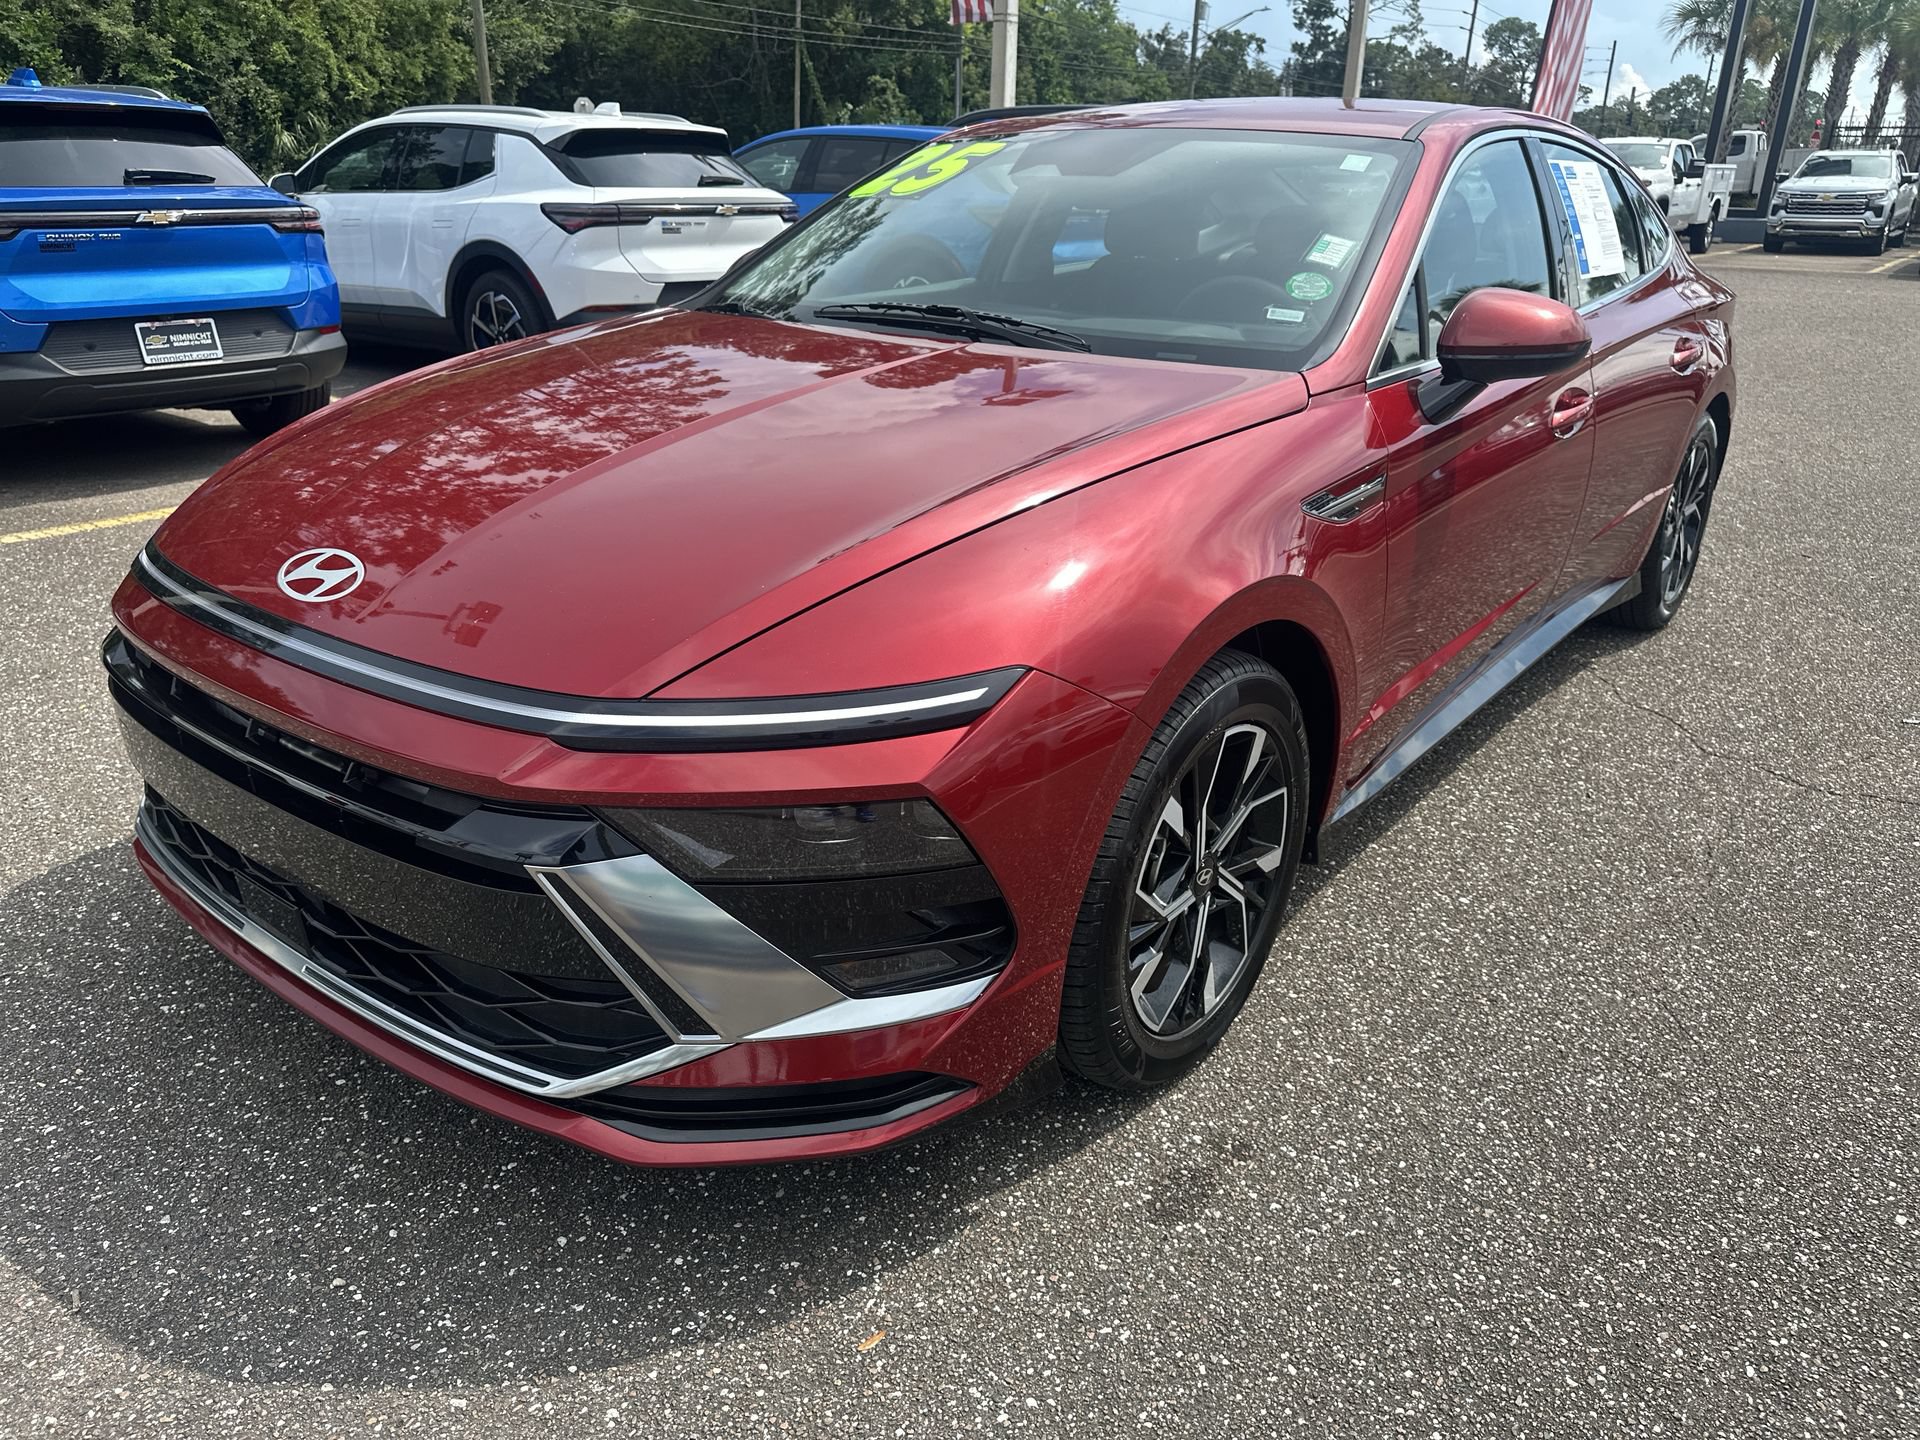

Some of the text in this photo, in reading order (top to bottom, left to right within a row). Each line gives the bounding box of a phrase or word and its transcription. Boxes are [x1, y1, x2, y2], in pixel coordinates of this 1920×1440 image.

[848, 142, 1007, 198] 25
[170, 332, 211, 342] NIMNICHT
[150, 352, 218, 363] nimnicht.com
